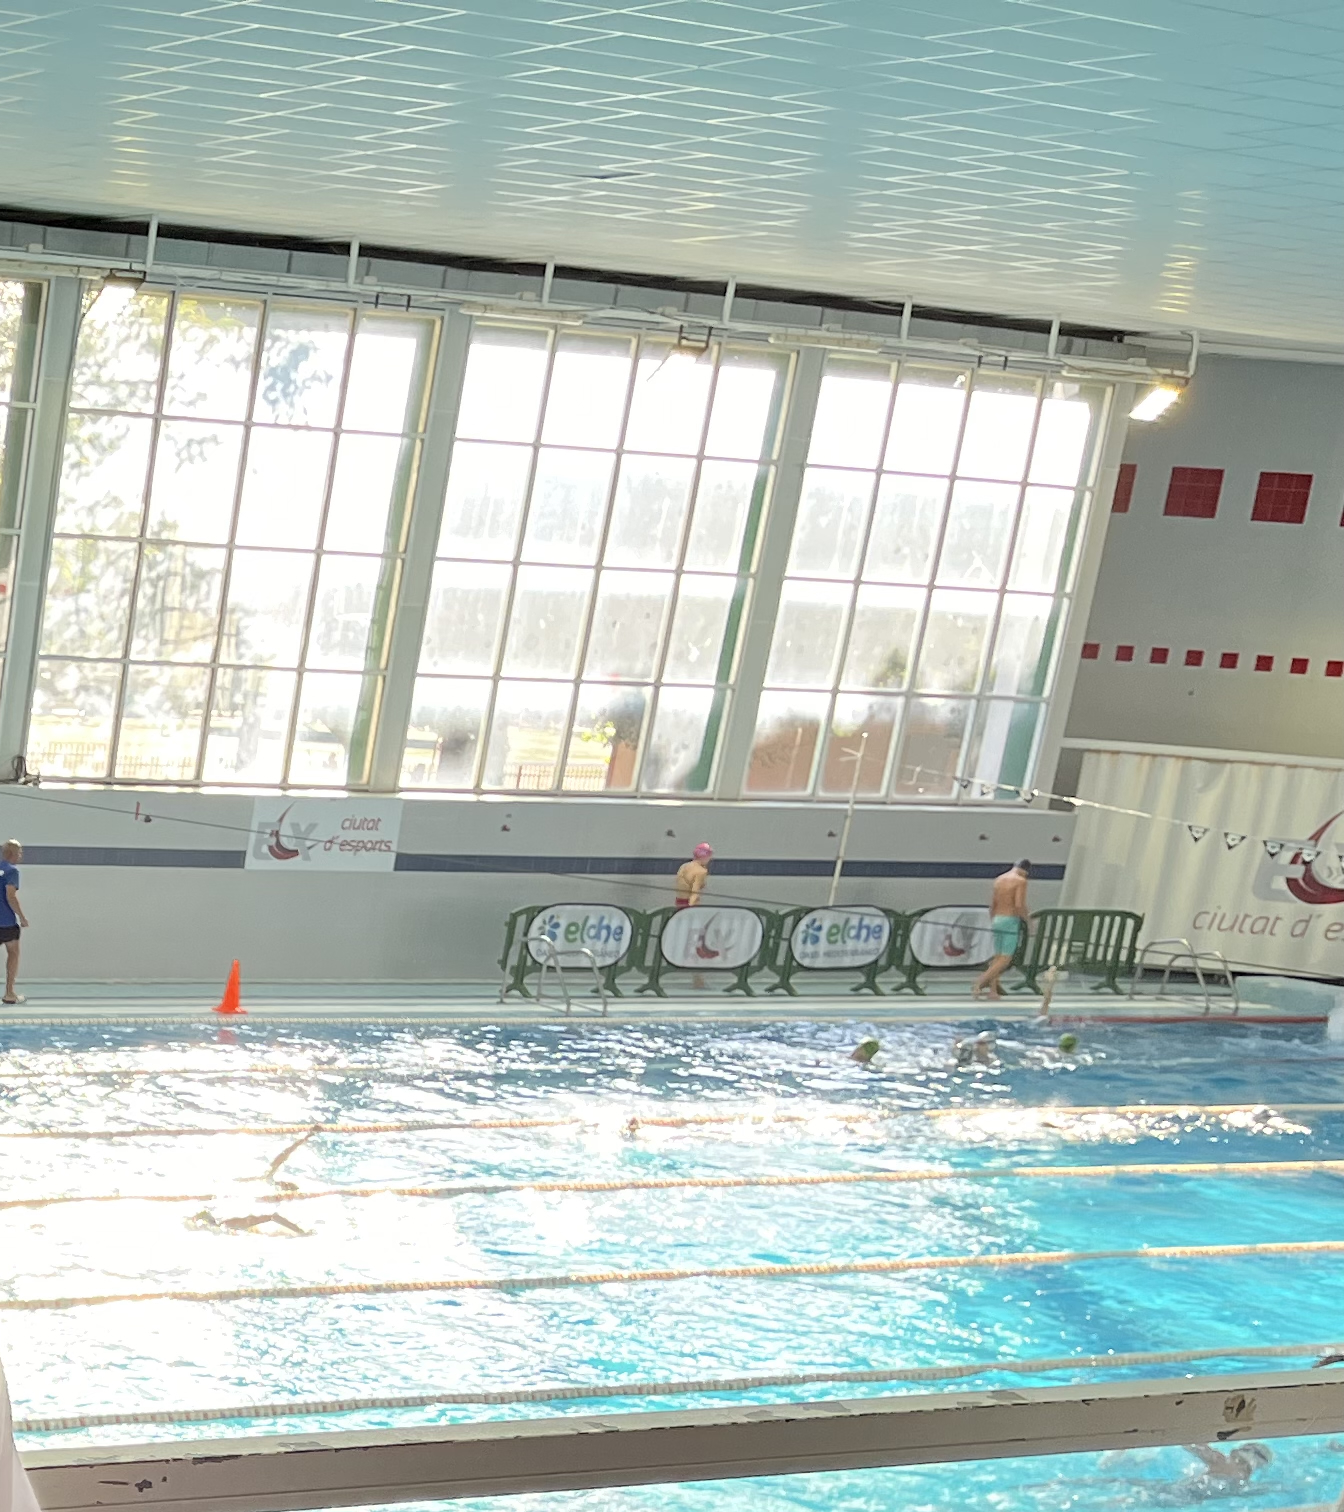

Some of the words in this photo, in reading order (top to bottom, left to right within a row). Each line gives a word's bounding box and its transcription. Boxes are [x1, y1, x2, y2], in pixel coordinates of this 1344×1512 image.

[341, 814, 382, 831] ciutat
[564, 915, 623, 944] elche
[826, 916, 883, 944] elche
[1192, 905, 1283, 937] ciutat
